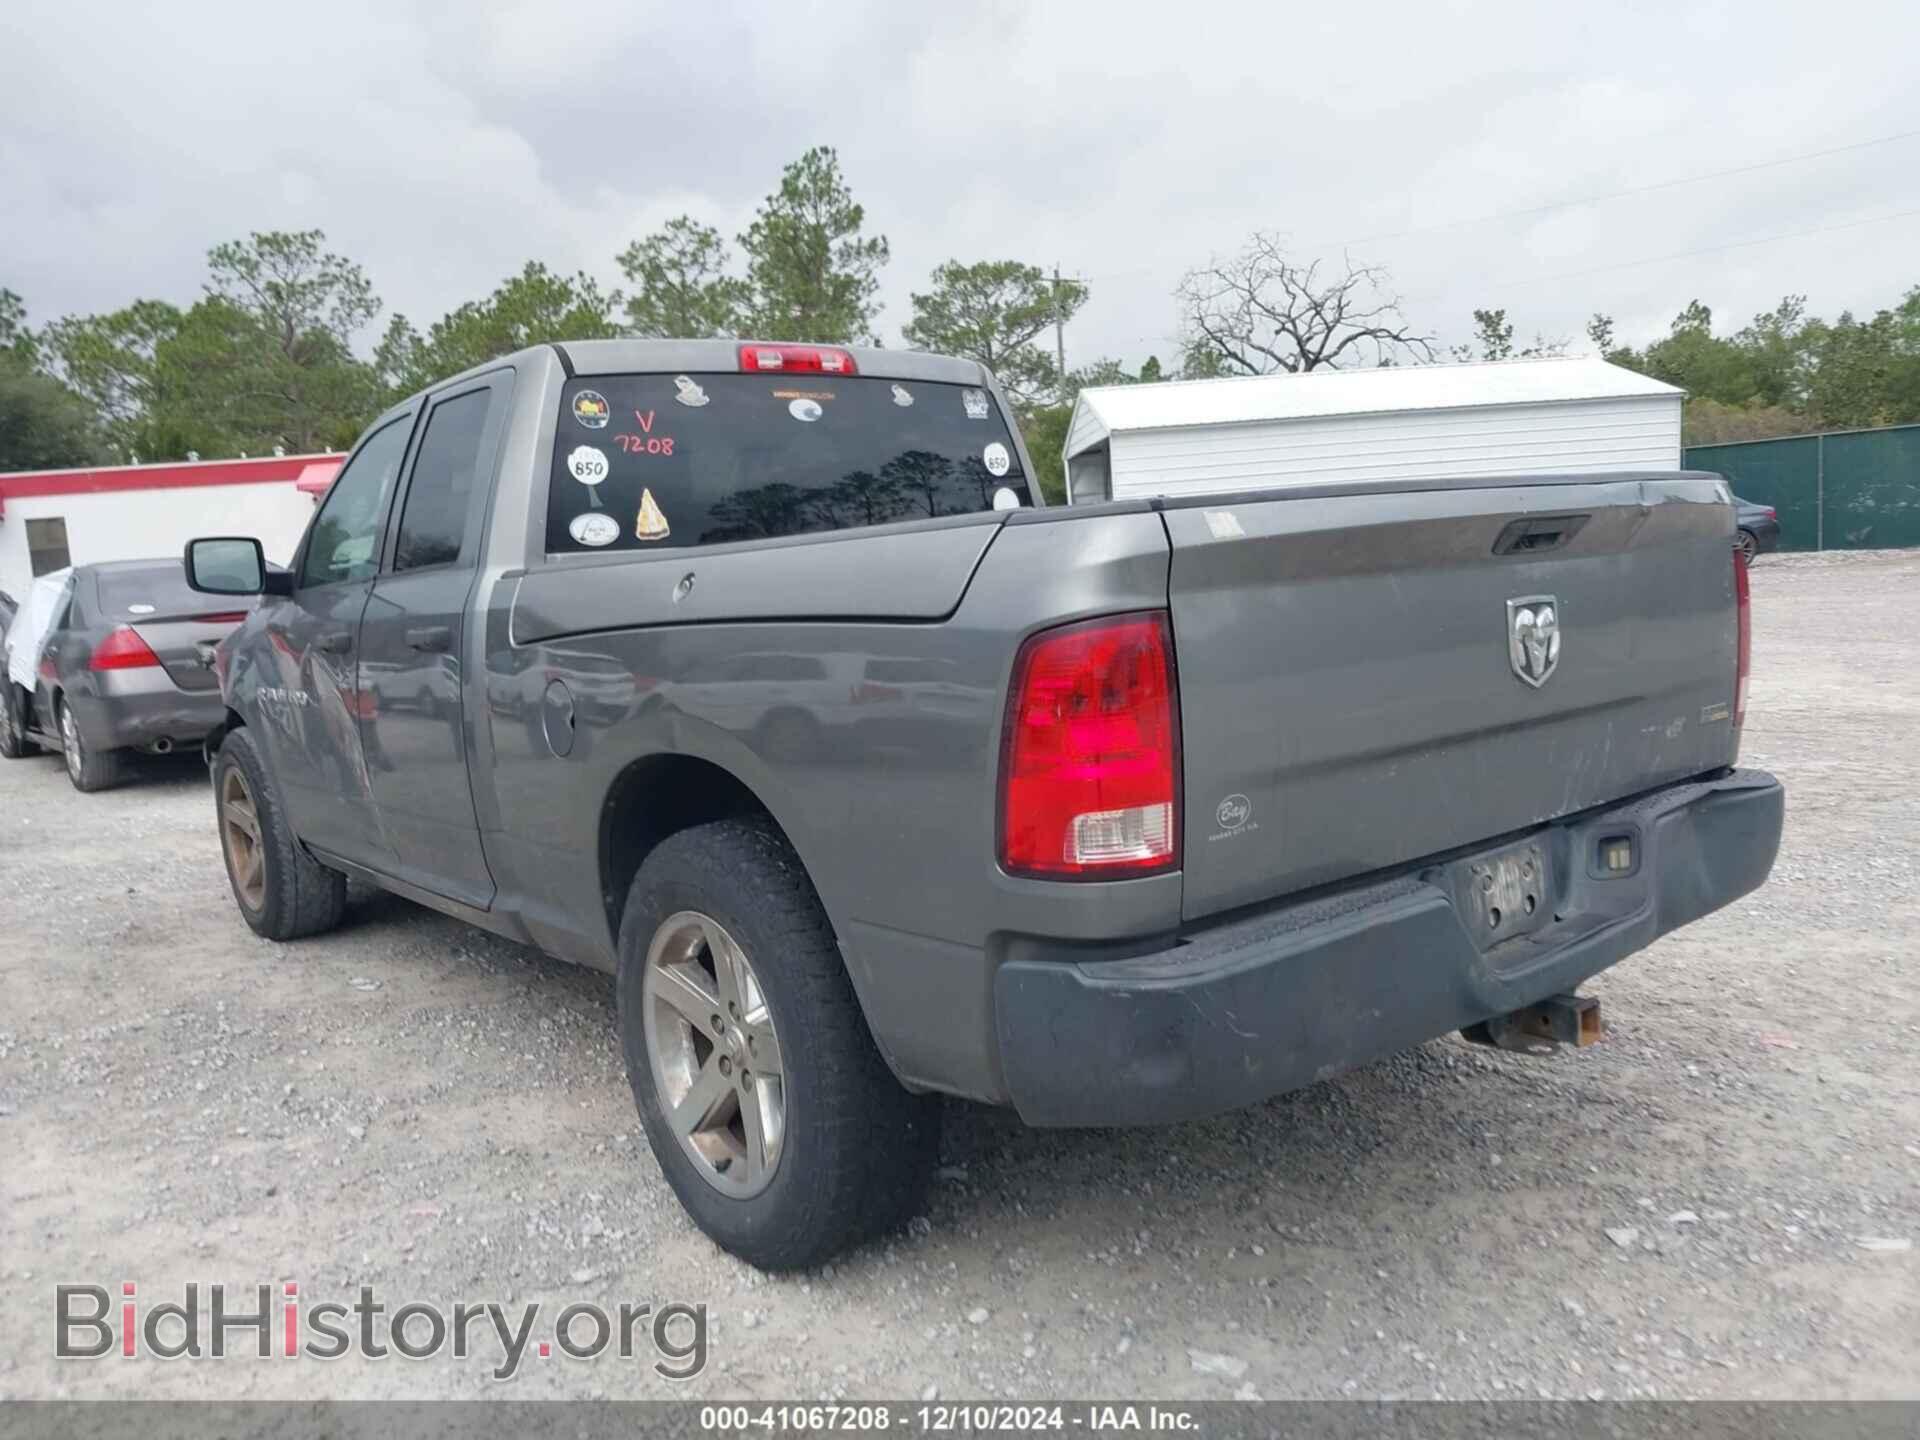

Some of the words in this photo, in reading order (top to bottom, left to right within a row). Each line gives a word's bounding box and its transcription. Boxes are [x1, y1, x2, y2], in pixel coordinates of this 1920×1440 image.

[635, 409, 655, 433] V
[614, 434, 674, 456] 7208
[574, 461, 604, 476] 850
